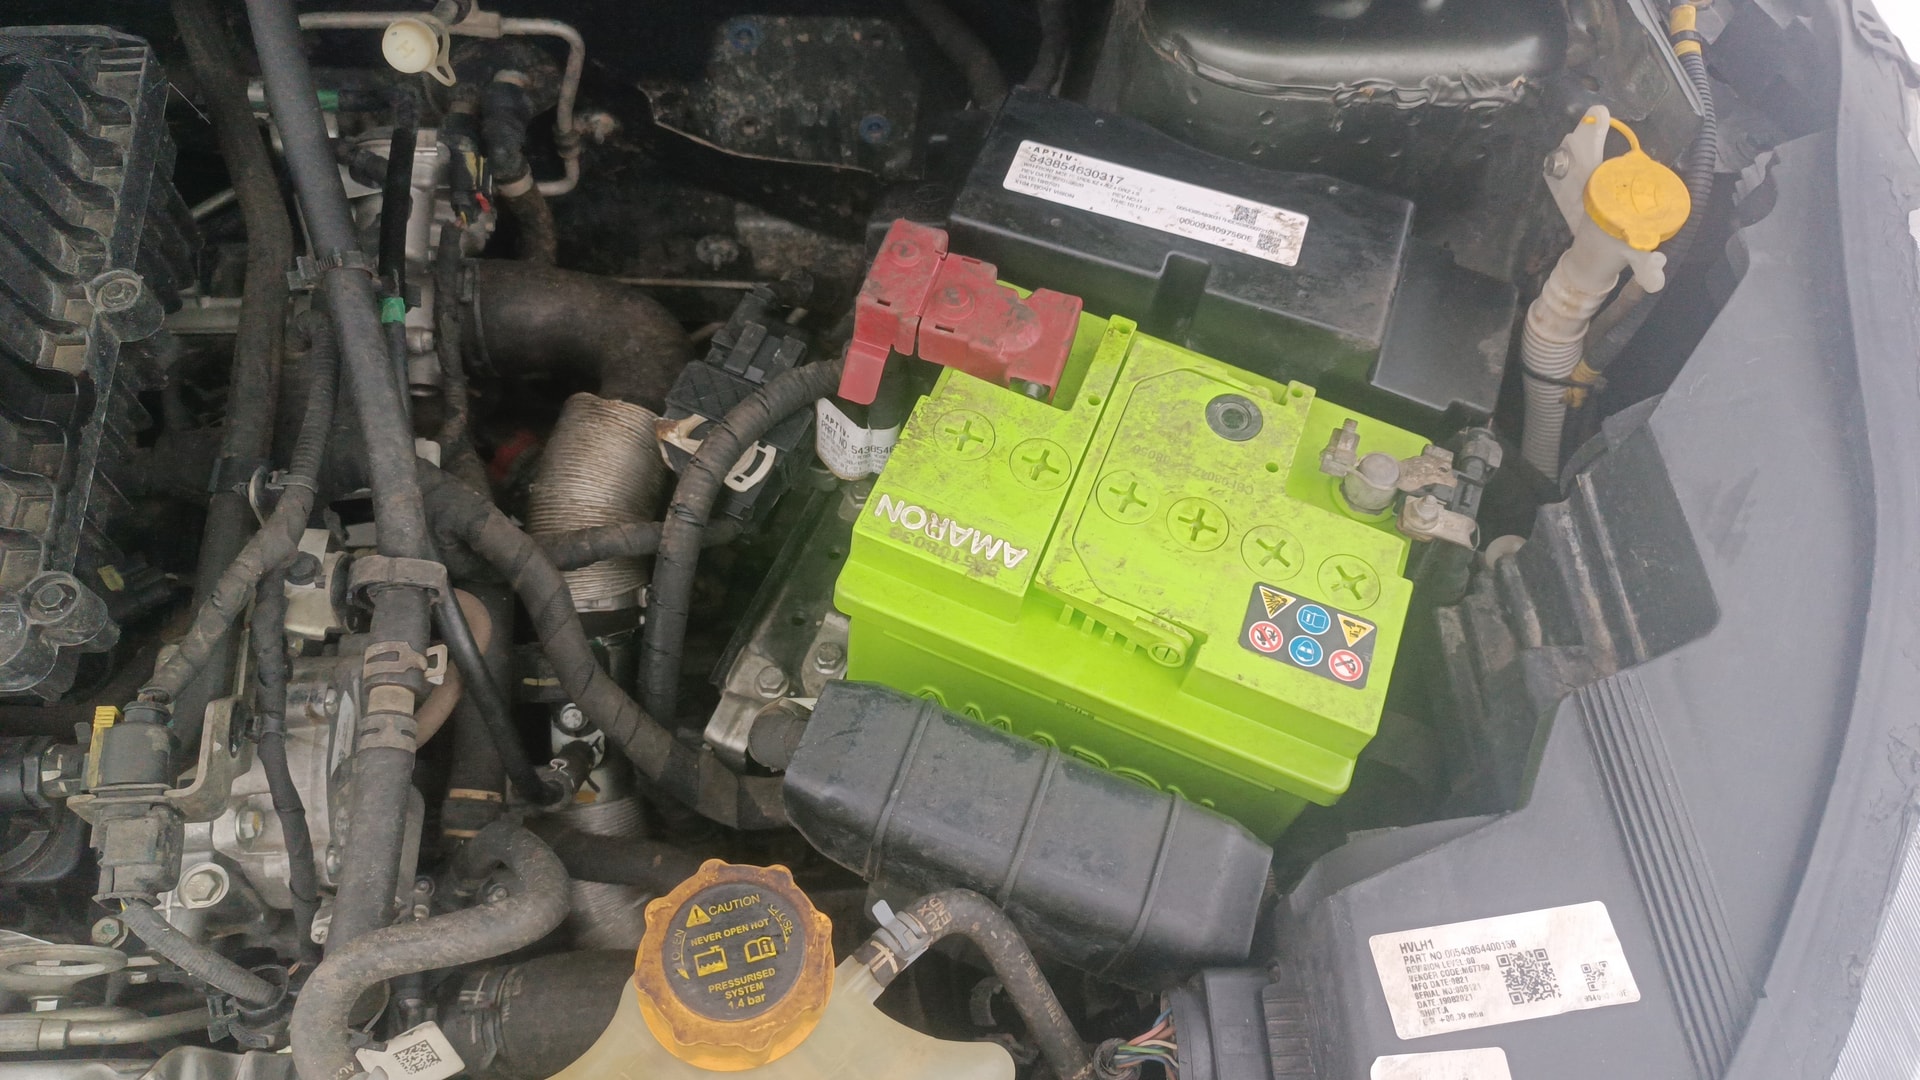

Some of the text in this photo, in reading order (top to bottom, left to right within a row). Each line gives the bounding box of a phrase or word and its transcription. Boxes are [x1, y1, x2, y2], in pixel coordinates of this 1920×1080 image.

[1029, 154, 1124, 185] 543854630317
[874, 493, 1028, 568] AMARON
[708, 894, 760, 916] CAUTION
[916, 903, 943, 933] AUX
[691, 918, 770, 947] NEVER OPEN HOT
[672, 929, 685, 961] OEN
[1399, 939, 1435, 954] HVLH1
[1403, 954, 1427, 966] PART
[1406, 963, 1441, 974] REVISION
[708, 967, 776, 993] PRESSURISED
[1408, 972, 1438, 983] VENDER
[1411, 981, 1429, 992] MFG
[725, 981, 765, 1000] SYSTEM
[1414, 989, 1441, 1000] SERIAL
[728, 992, 767, 1010] 1.4 bar
